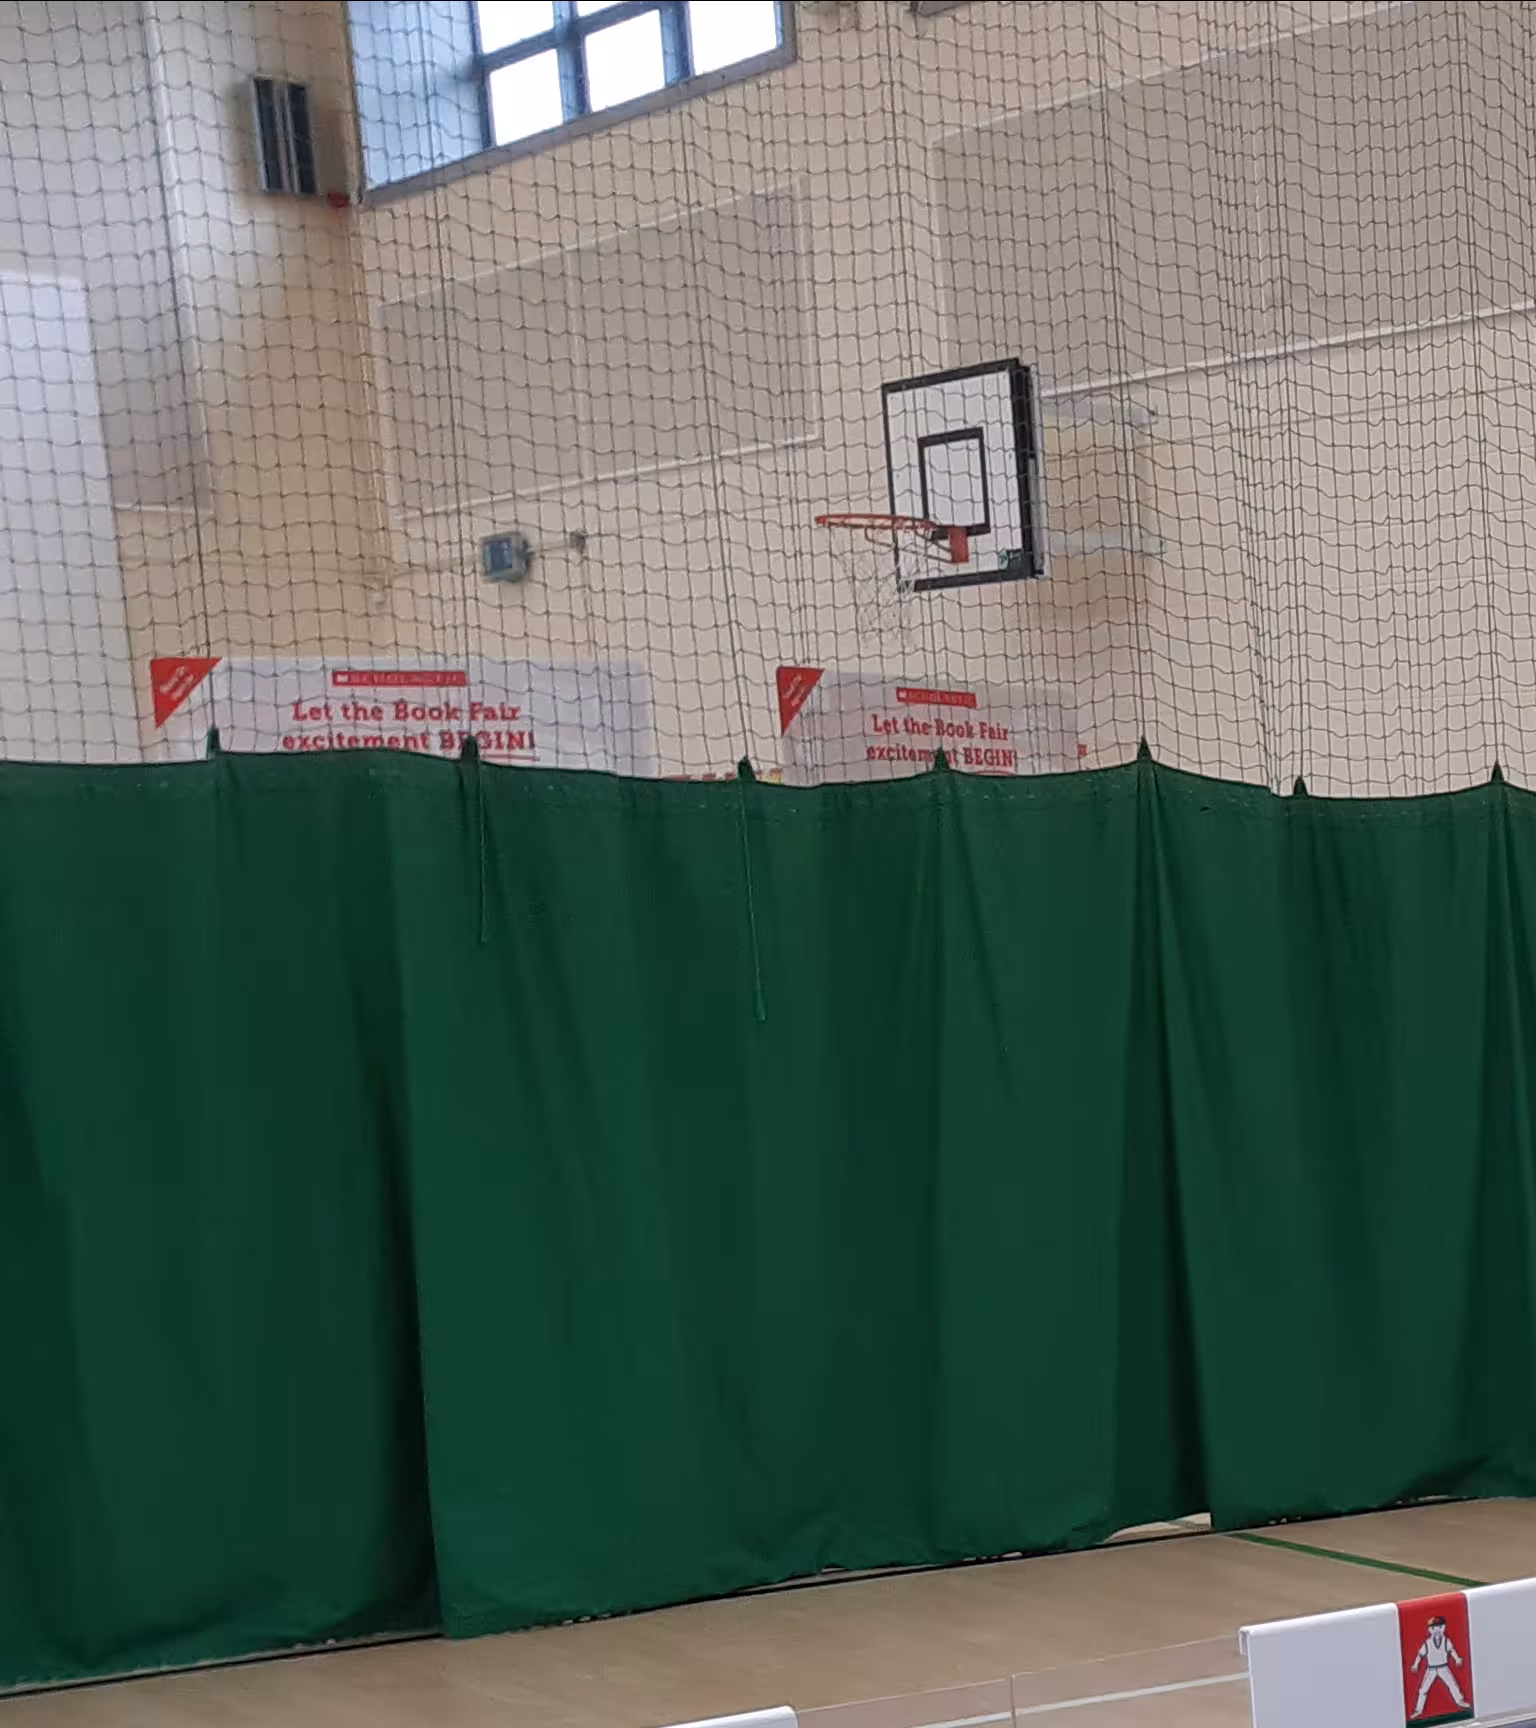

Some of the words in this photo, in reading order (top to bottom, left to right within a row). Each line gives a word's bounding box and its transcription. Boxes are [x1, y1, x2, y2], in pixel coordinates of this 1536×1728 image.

[293, 700, 332, 721] Let
[341, 702, 384, 721] the
[393, 700, 460, 721] Book
[469, 702, 521, 721] Fair
[872, 714, 899, 734] Let
[903, 717, 933, 736] the
[934, 718, 974, 739] Book
[978, 721, 1008, 741] Fair
[282, 731, 431, 750] excitement
